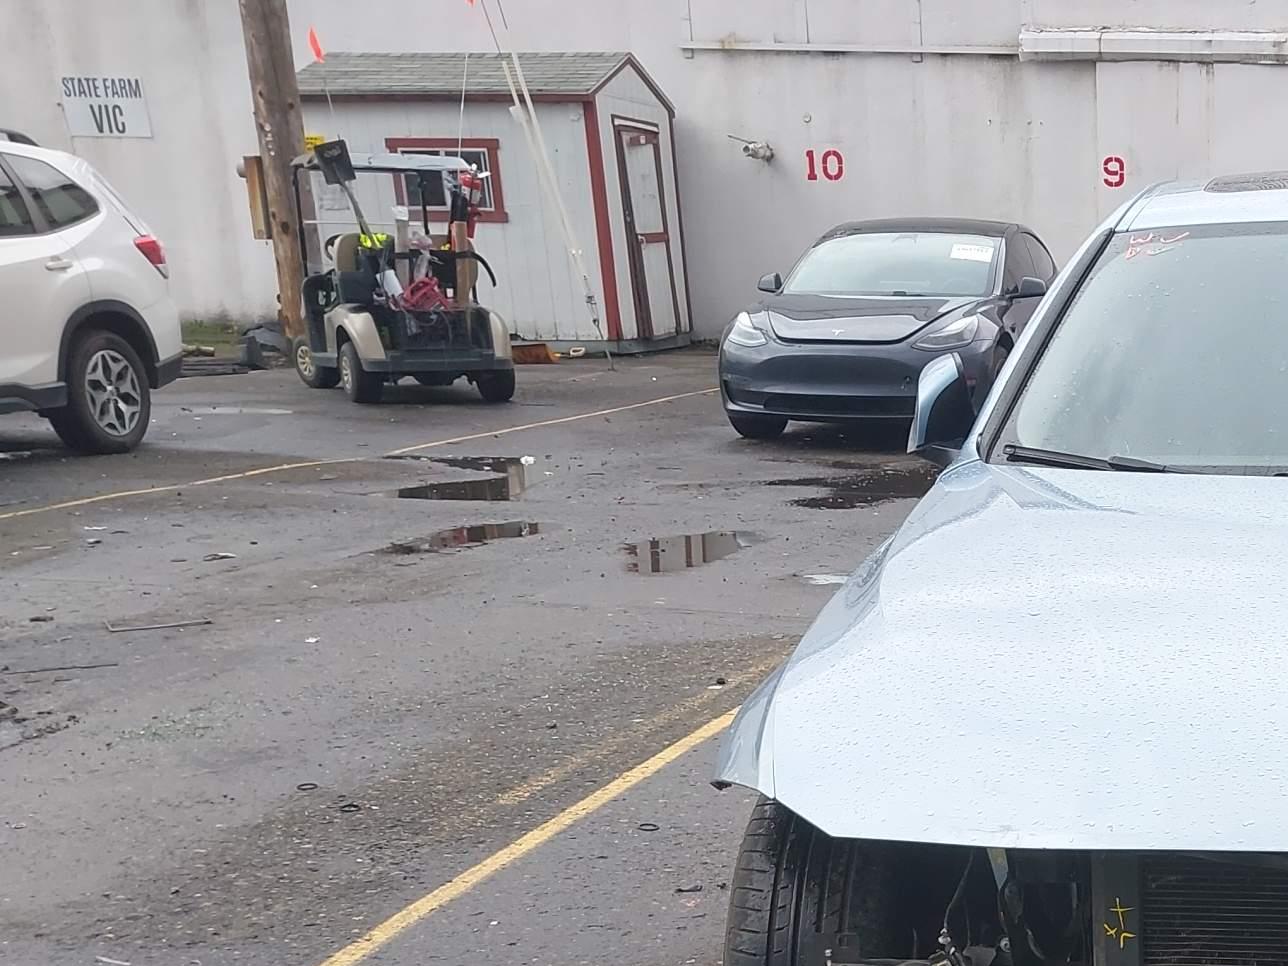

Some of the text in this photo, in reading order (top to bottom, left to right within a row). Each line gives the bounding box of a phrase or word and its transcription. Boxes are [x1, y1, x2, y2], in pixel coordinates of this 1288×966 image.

[62, 77, 142, 98] STATE FARM
[89, 103, 126, 134] VIC
[805, 149, 844, 181] 10
[1103, 156, 1125, 187] 9
